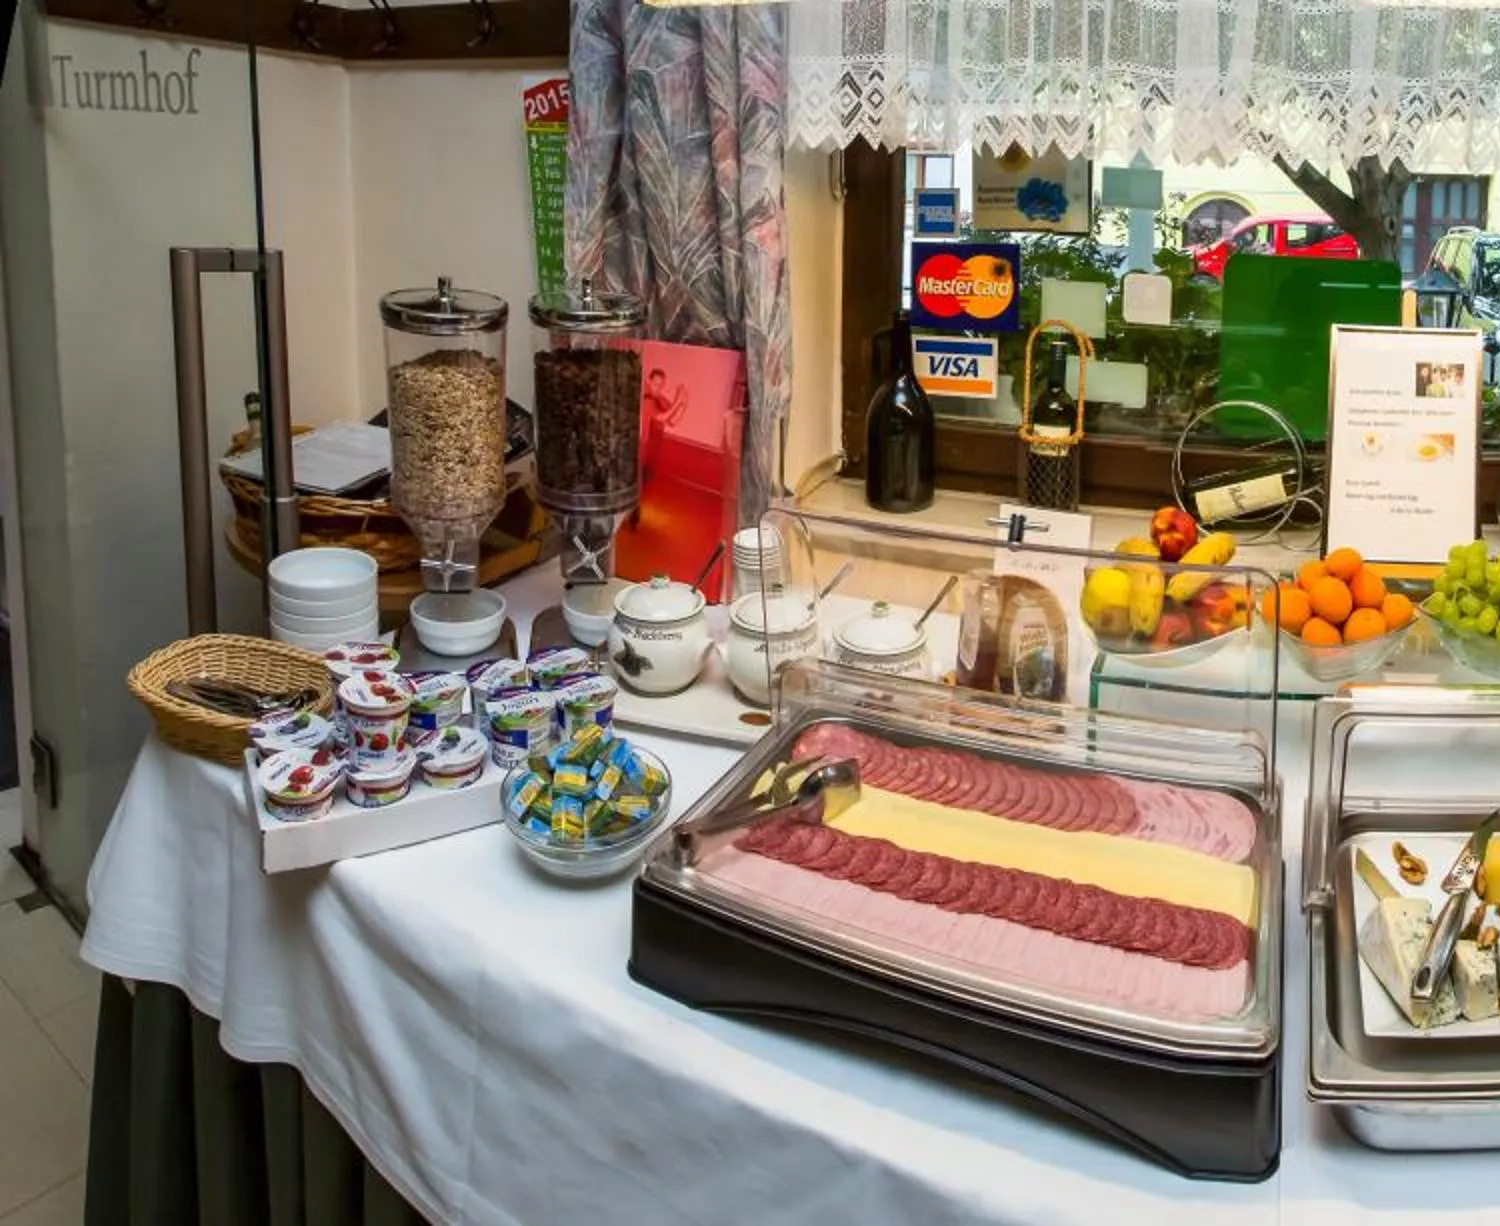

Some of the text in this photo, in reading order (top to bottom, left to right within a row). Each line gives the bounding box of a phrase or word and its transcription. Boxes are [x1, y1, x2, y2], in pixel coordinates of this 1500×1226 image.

[52, 48, 201, 115] Turmhof
[525, 83, 569, 119] 2015
[919, 275, 1010, 297] MasterCard
[928, 354, 979, 378] VISA
